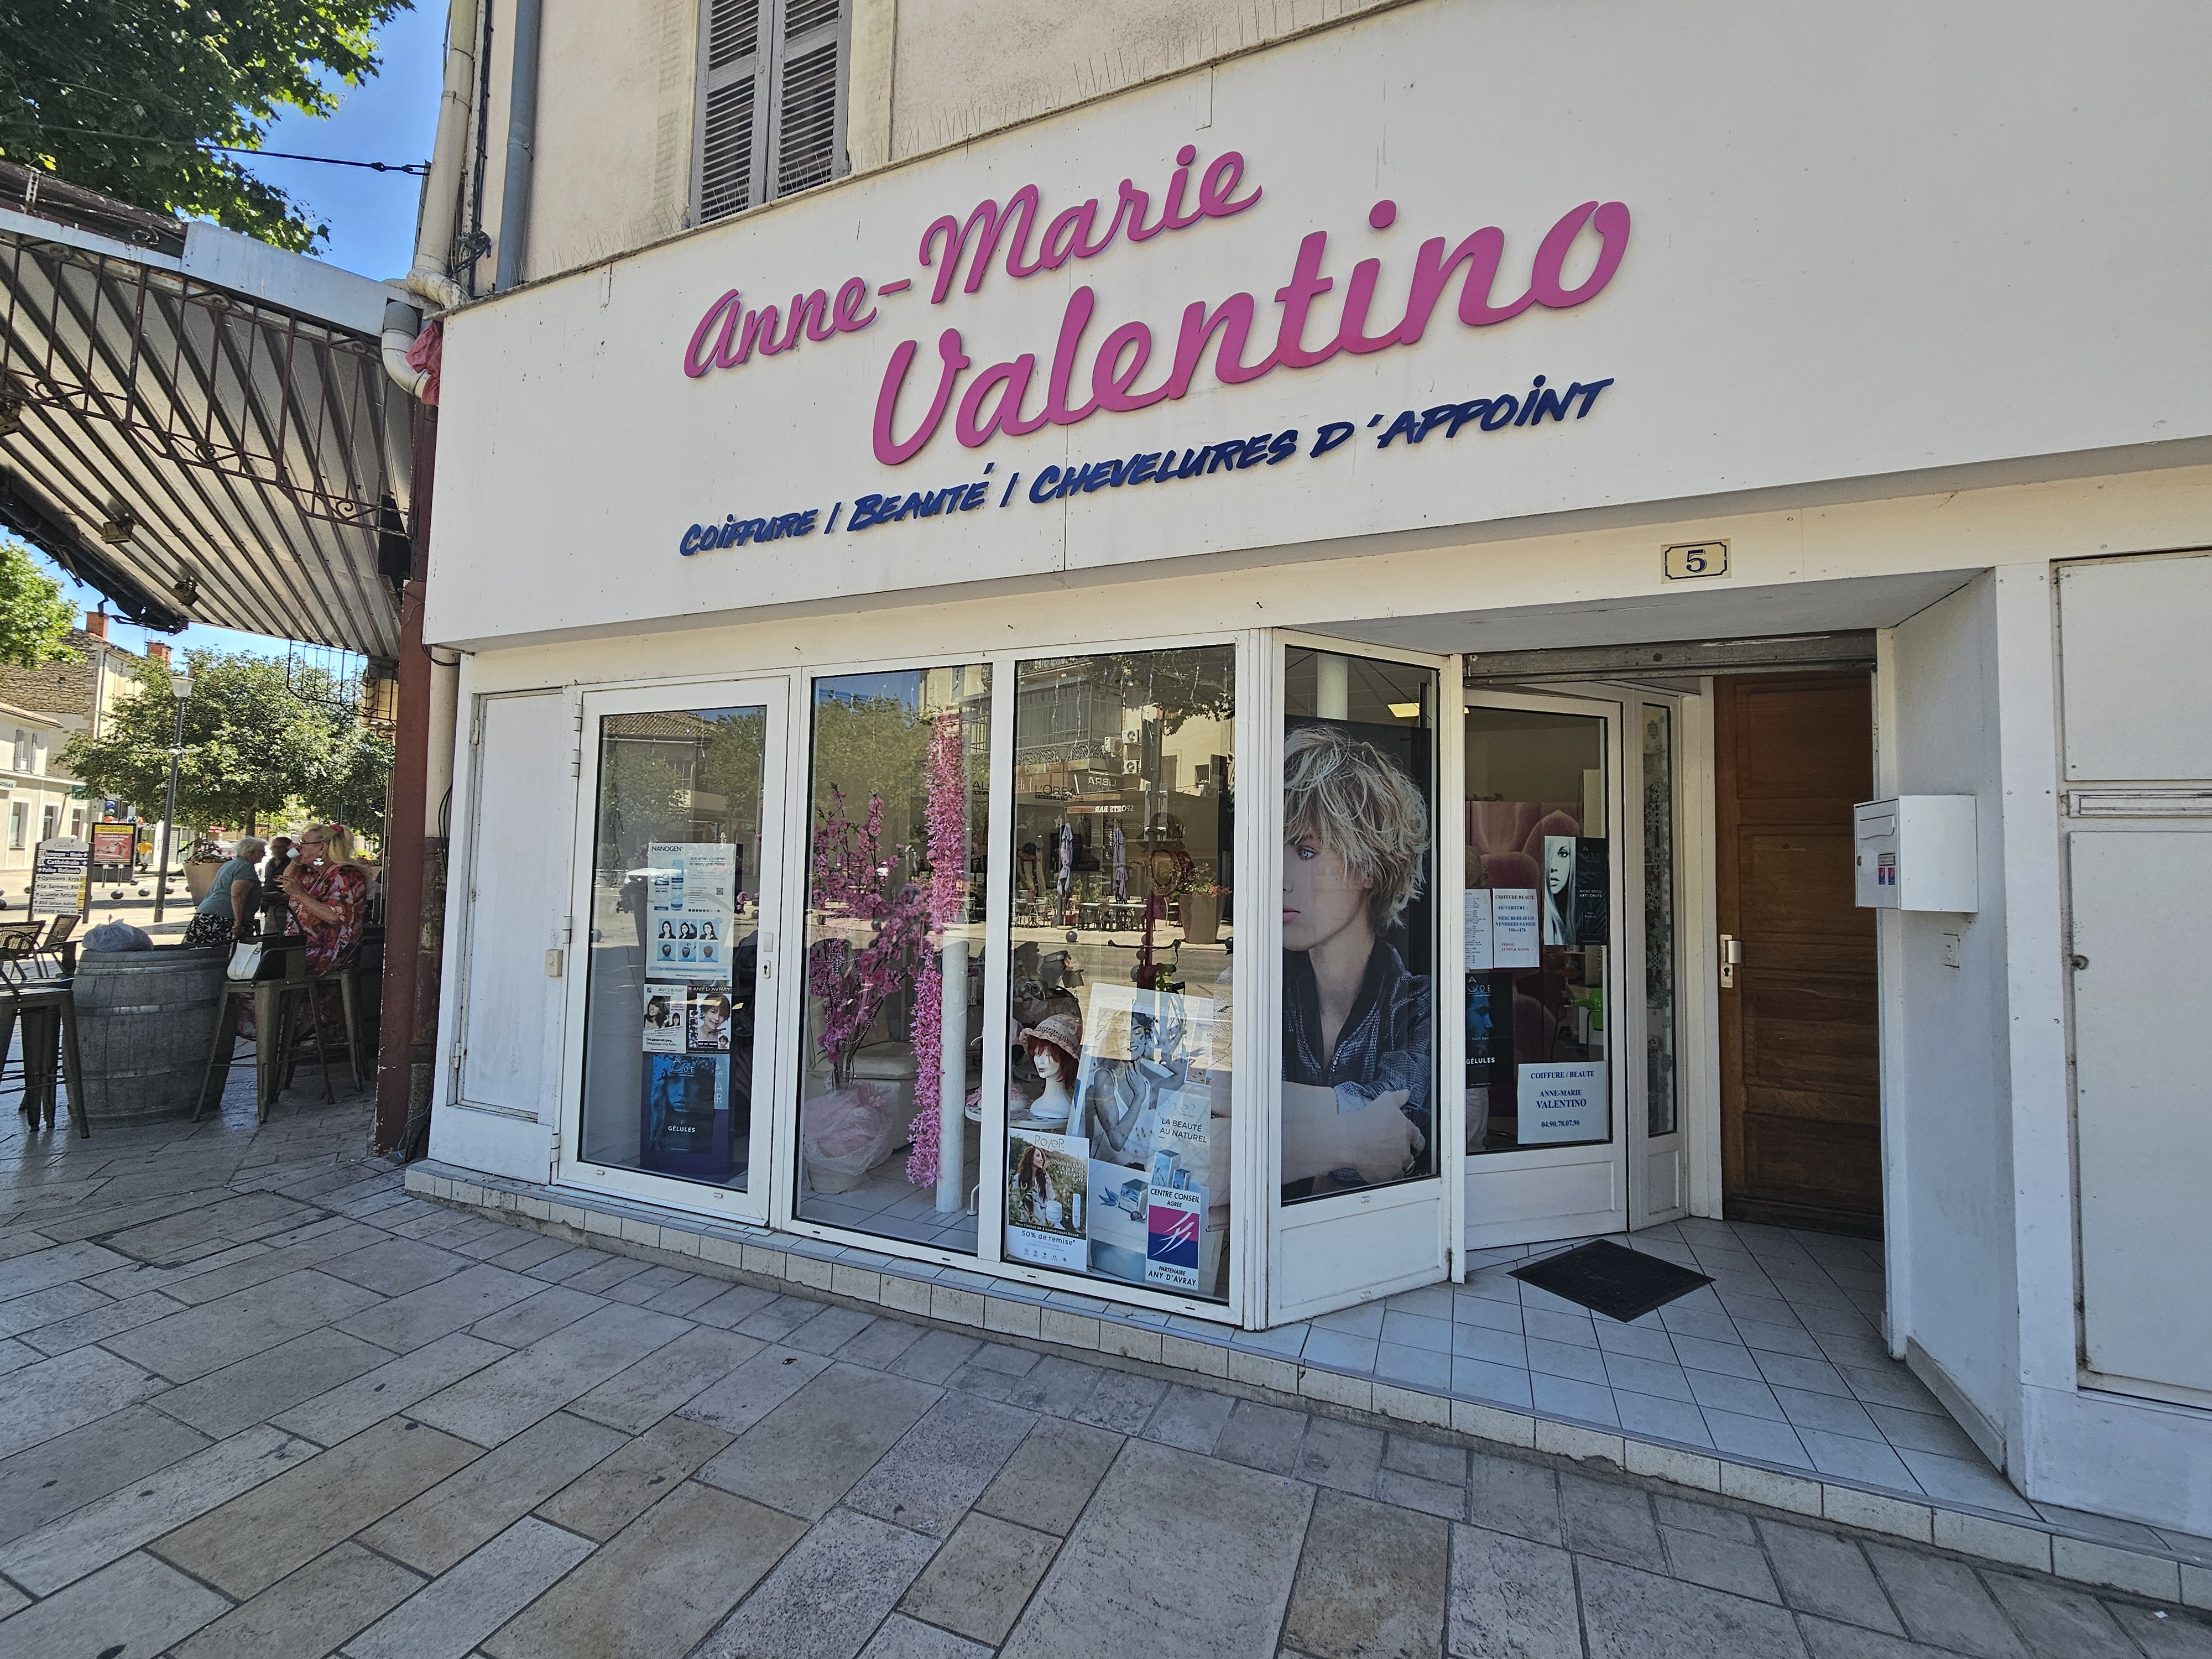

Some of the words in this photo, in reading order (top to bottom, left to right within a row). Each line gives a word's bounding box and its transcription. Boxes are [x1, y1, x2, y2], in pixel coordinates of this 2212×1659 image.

[684, 144, 1262, 378] Anne-Marie
[873, 200, 1631, 466] Valentino
[847, 462, 994, 532] BEAUTÉ
[1029, 430, 1297, 503] CHEVELURES
[1686, 549, 1707, 573] 5
[1536, 1098, 1587, 1109] VALENTINO
[1172, 1120, 1202, 1132] BEAUTÉ
[1172, 1130, 1207, 1143] NATUREL
[1150, 1188, 1173, 1198] CENTRE
[1174, 1192, 1200, 1203] CONSEIL
[1148, 1270, 1163, 1279] ANY
[1166, 1274, 1196, 1286] D'AVRAY
[1159, 1266, 1186, 1276] PARTENAIRE
